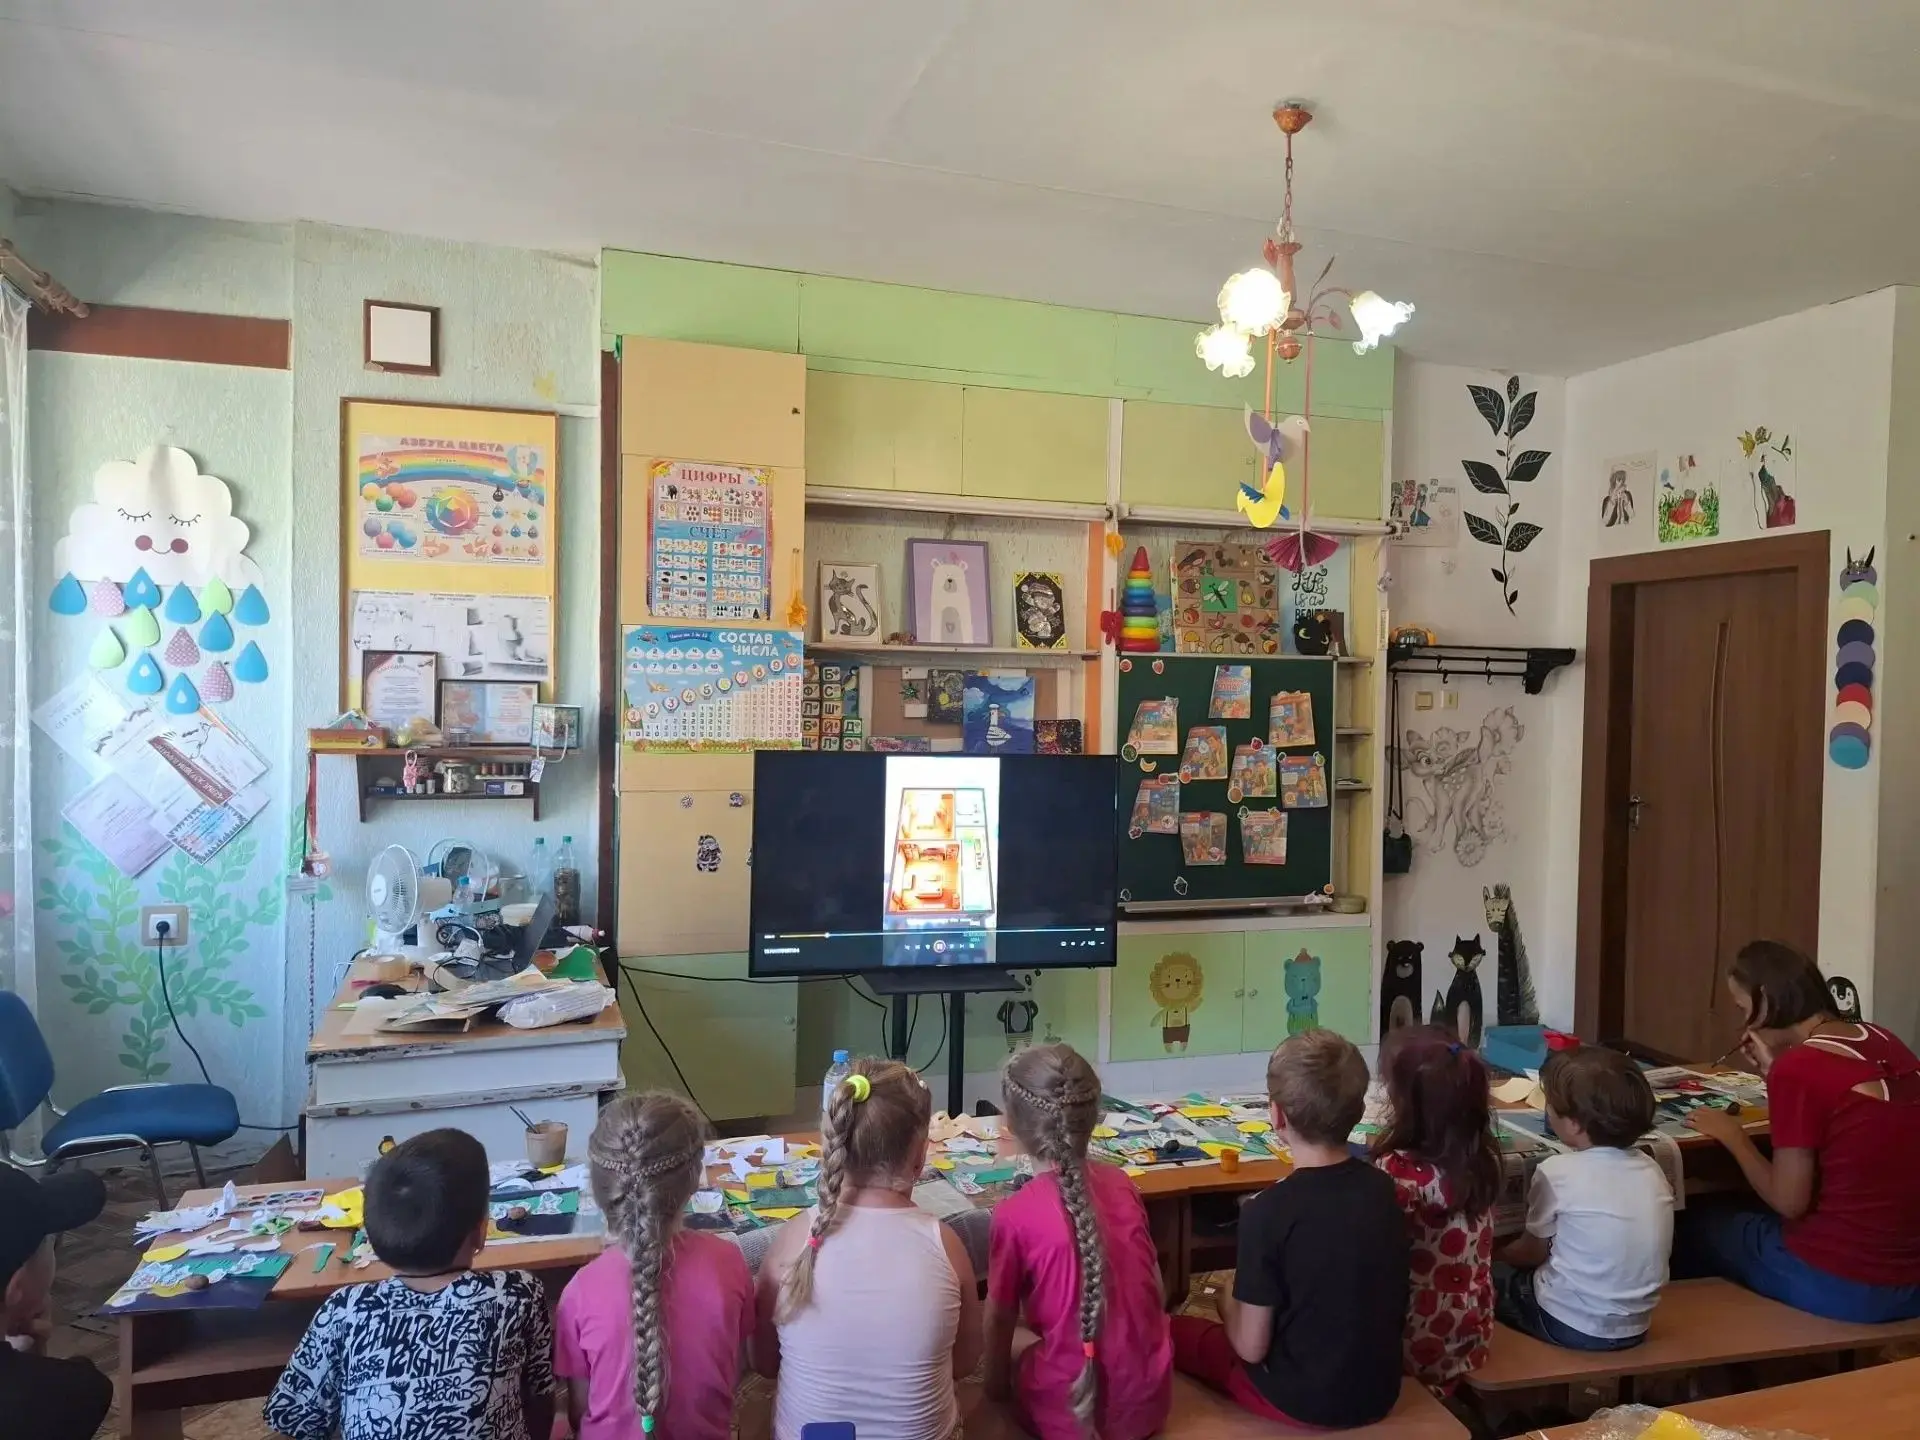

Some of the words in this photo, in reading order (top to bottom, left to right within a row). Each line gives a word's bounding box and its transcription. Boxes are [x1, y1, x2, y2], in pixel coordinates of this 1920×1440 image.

[681, 469, 742, 484] ЦИФРЫ
[744, 510, 753, 518] 10
[689, 525, 730, 538] СЧЁТ
[719, 632, 773, 645] СОСТАВ
[732, 644, 779, 656] ЧИСЛА
[825, 669, 833, 679] Б
[803, 685, 813, 696] Ф
[824, 686, 833, 696] С
[803, 703, 812, 714] Л
[825, 704, 834, 714] Ш
[804, 721, 812, 730] Б
[845, 722, 854, 732] Д
[823, 739, 832, 748] Л
[845, 739, 854, 749] Э
